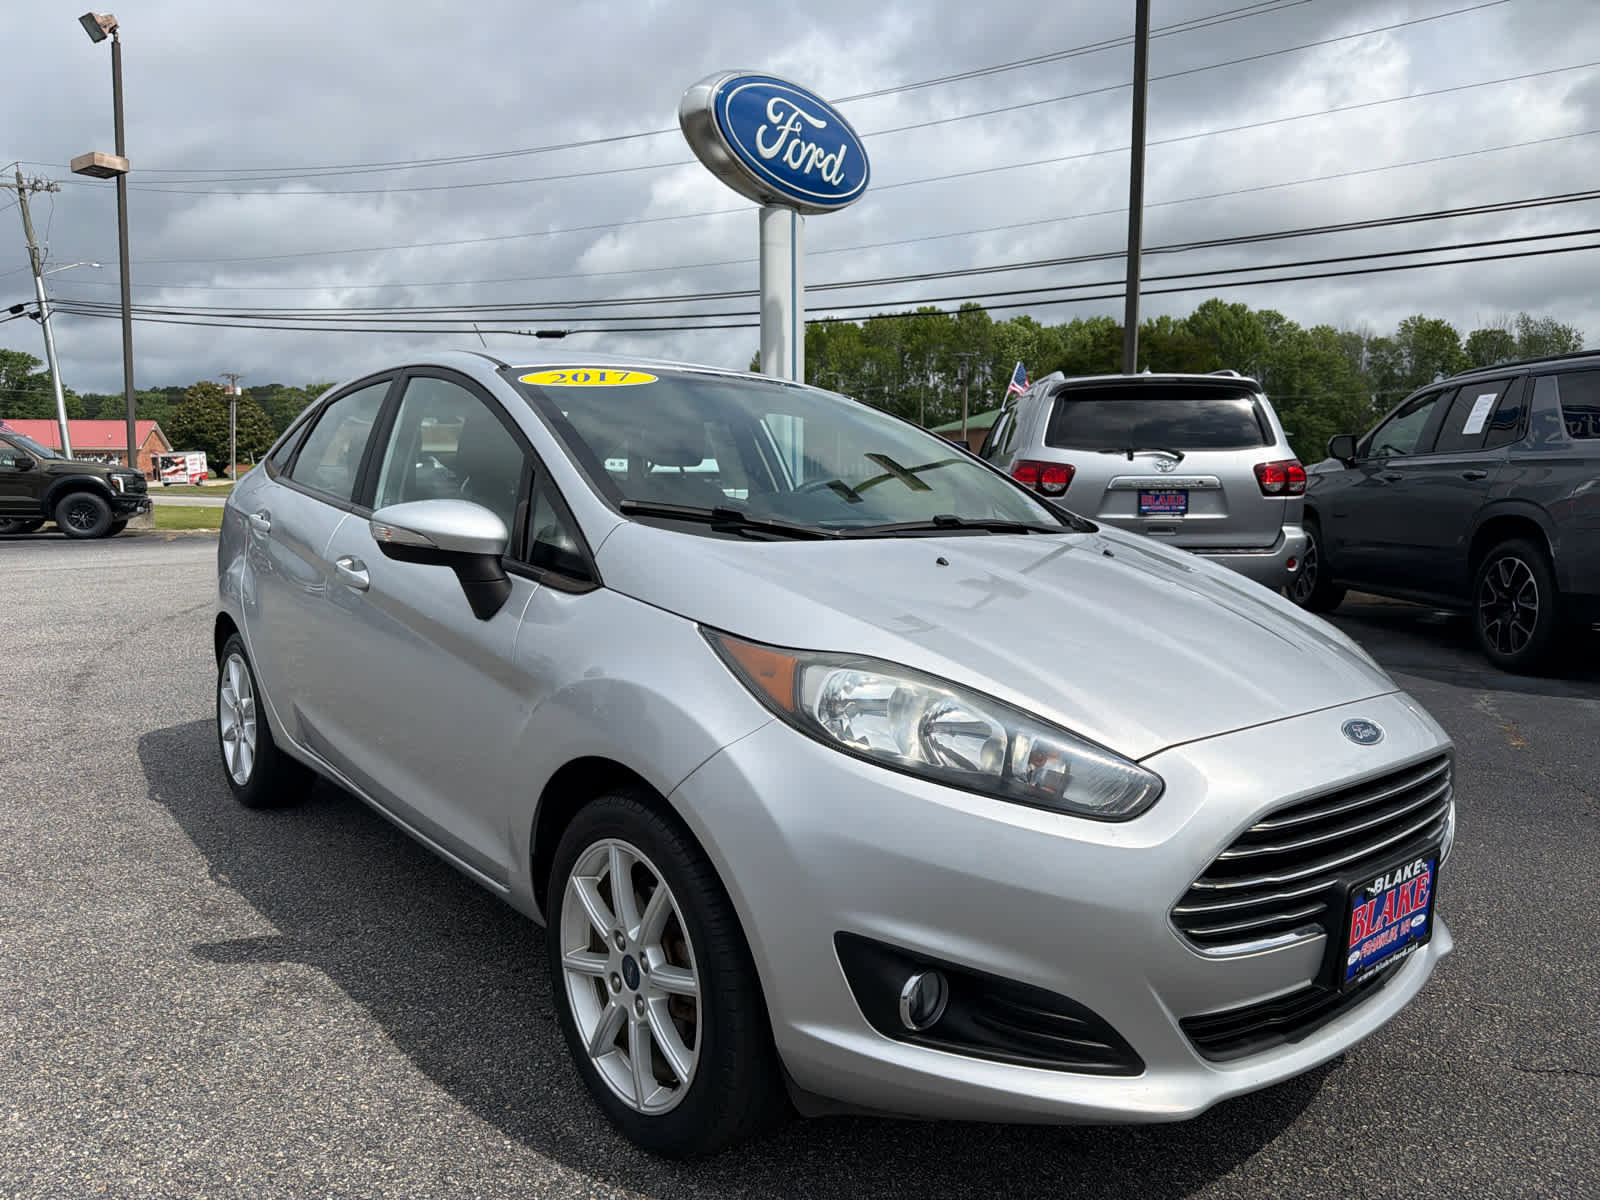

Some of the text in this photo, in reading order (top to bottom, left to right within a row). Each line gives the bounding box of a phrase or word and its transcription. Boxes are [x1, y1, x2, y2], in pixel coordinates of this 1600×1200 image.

[756, 97, 847, 185] Ford
[550, 371, 631, 384] 2017
[1141, 495, 1186, 505] BLAKE
[1374, 858, 1423, 894] BLAKE
[1349, 871, 1431, 948] BLAKE
